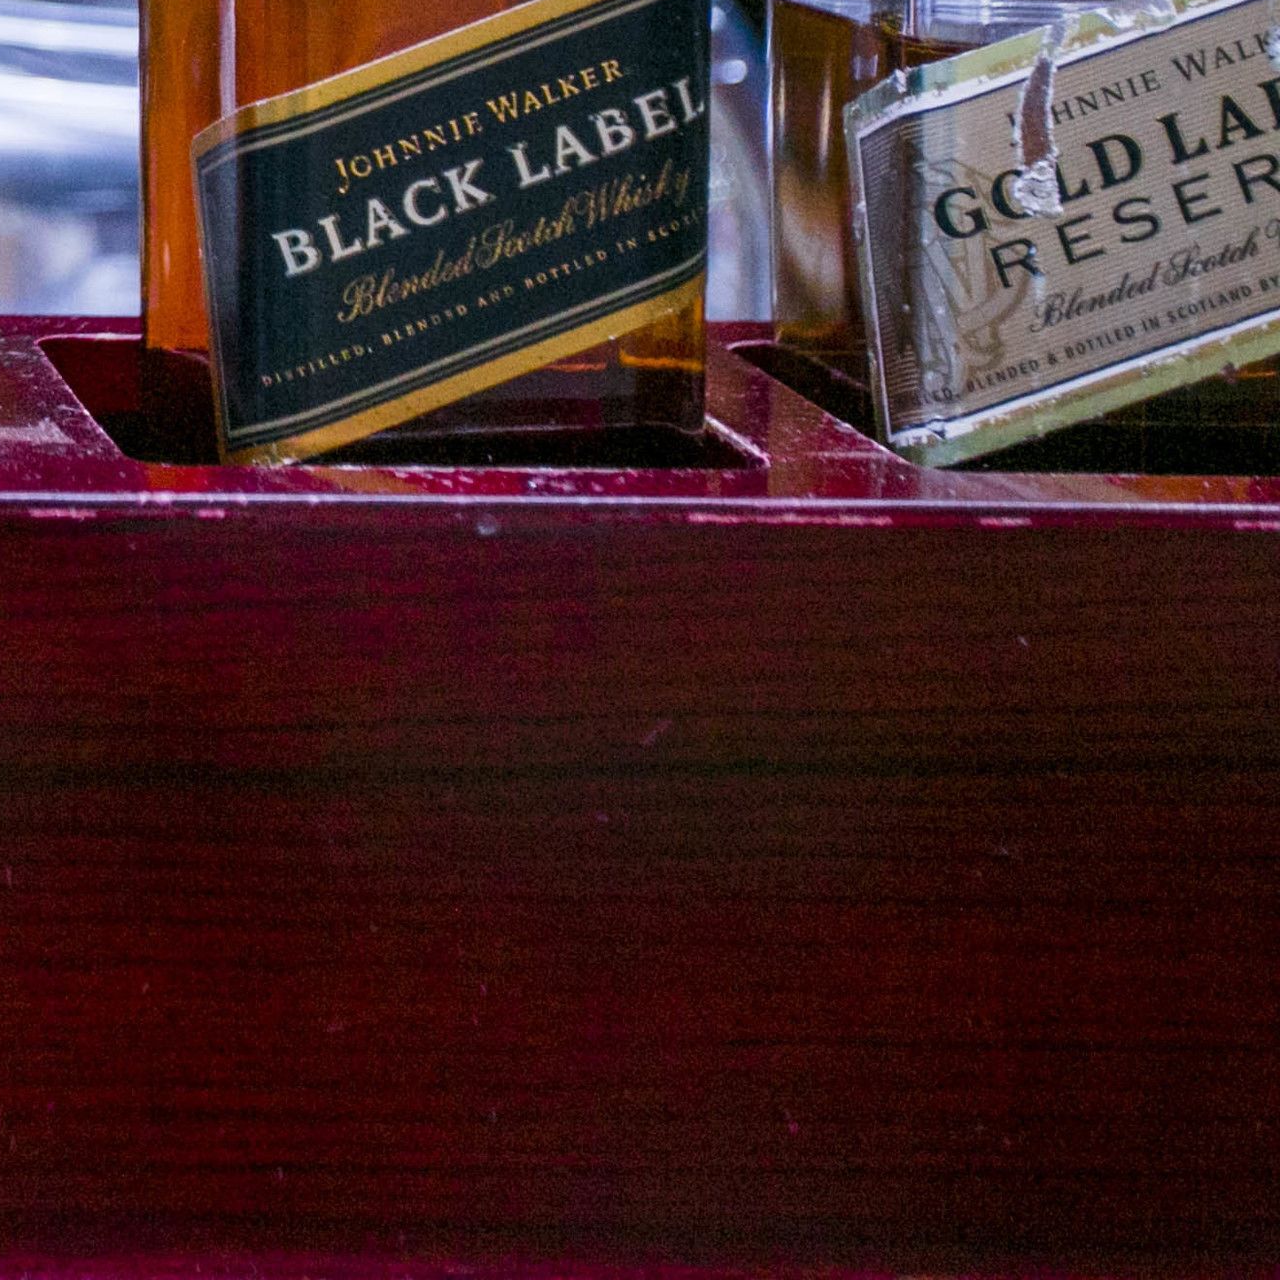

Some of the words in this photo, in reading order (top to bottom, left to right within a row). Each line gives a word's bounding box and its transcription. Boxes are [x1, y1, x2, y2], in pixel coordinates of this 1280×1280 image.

[334, 111, 484, 196] JOHNNIE
[485, 59, 624, 124] WALKER
[1007, 69, 1162, 148] HNNIE
[271, 157, 497, 278] BLACK
[505, 75, 706, 190] LABEL
[336, 235, 477, 323] Blended
[474, 196, 576, 269] Scotch
[573, 157, 690, 229] Whisky
[990, 153, 1280, 289] RESER
[380, 302, 469, 347] BLENDED
[476, 284, 515, 309] AND
[523, 249, 608, 291] BOTTLED
[615, 237, 638, 255] IN
[965, 358, 1040, 393] BLENDED
[1063, 323, 1137, 361] BOTTLED
[1141, 316, 1162, 334] IN
[1166, 284, 1253, 323] SCOTLAND
[1258, 274, 1280, 293] BY
[1029, 262, 1161, 333] Blended
[1161, 225, 1262, 287] Scotch
